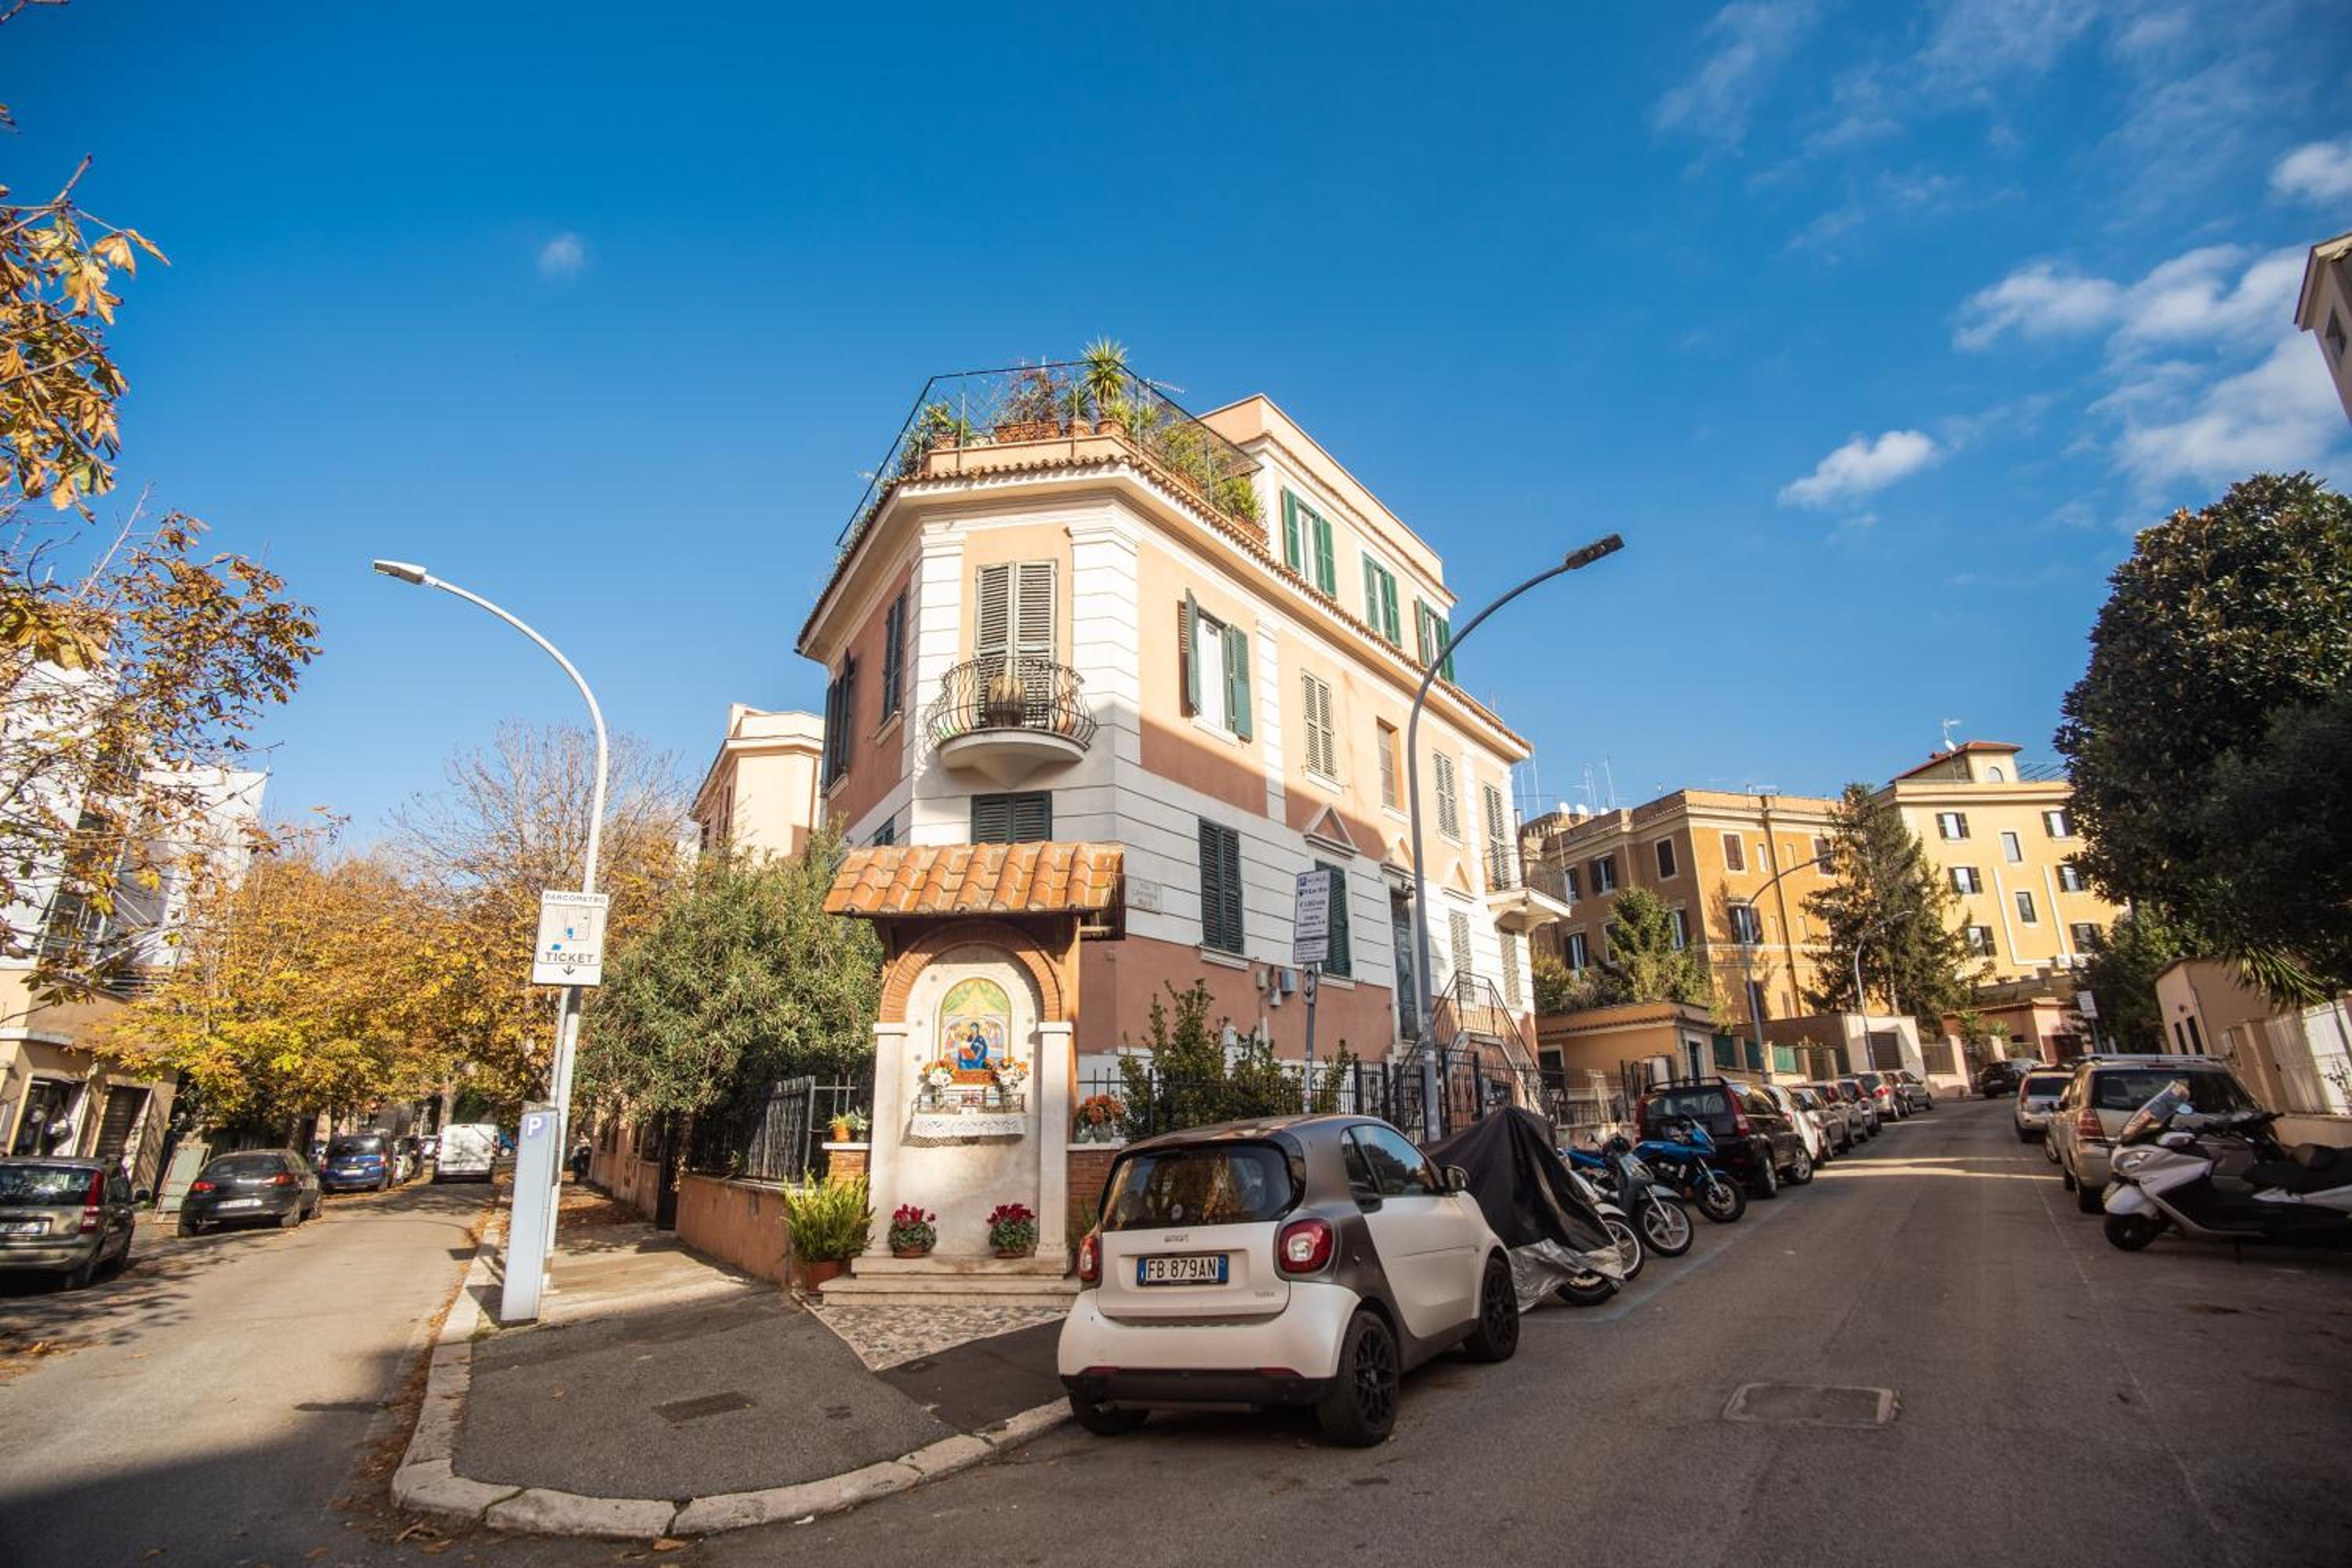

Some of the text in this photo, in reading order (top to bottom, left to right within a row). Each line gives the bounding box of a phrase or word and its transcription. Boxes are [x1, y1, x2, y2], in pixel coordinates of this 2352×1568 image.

[545, 894, 605, 903] PARCOMETRO
[545, 952, 594, 964] TICKET
[528, 1117, 542, 1136] P
[1147, 1261, 1164, 1279] FB
[1171, 1258, 1216, 1277] 879AN
